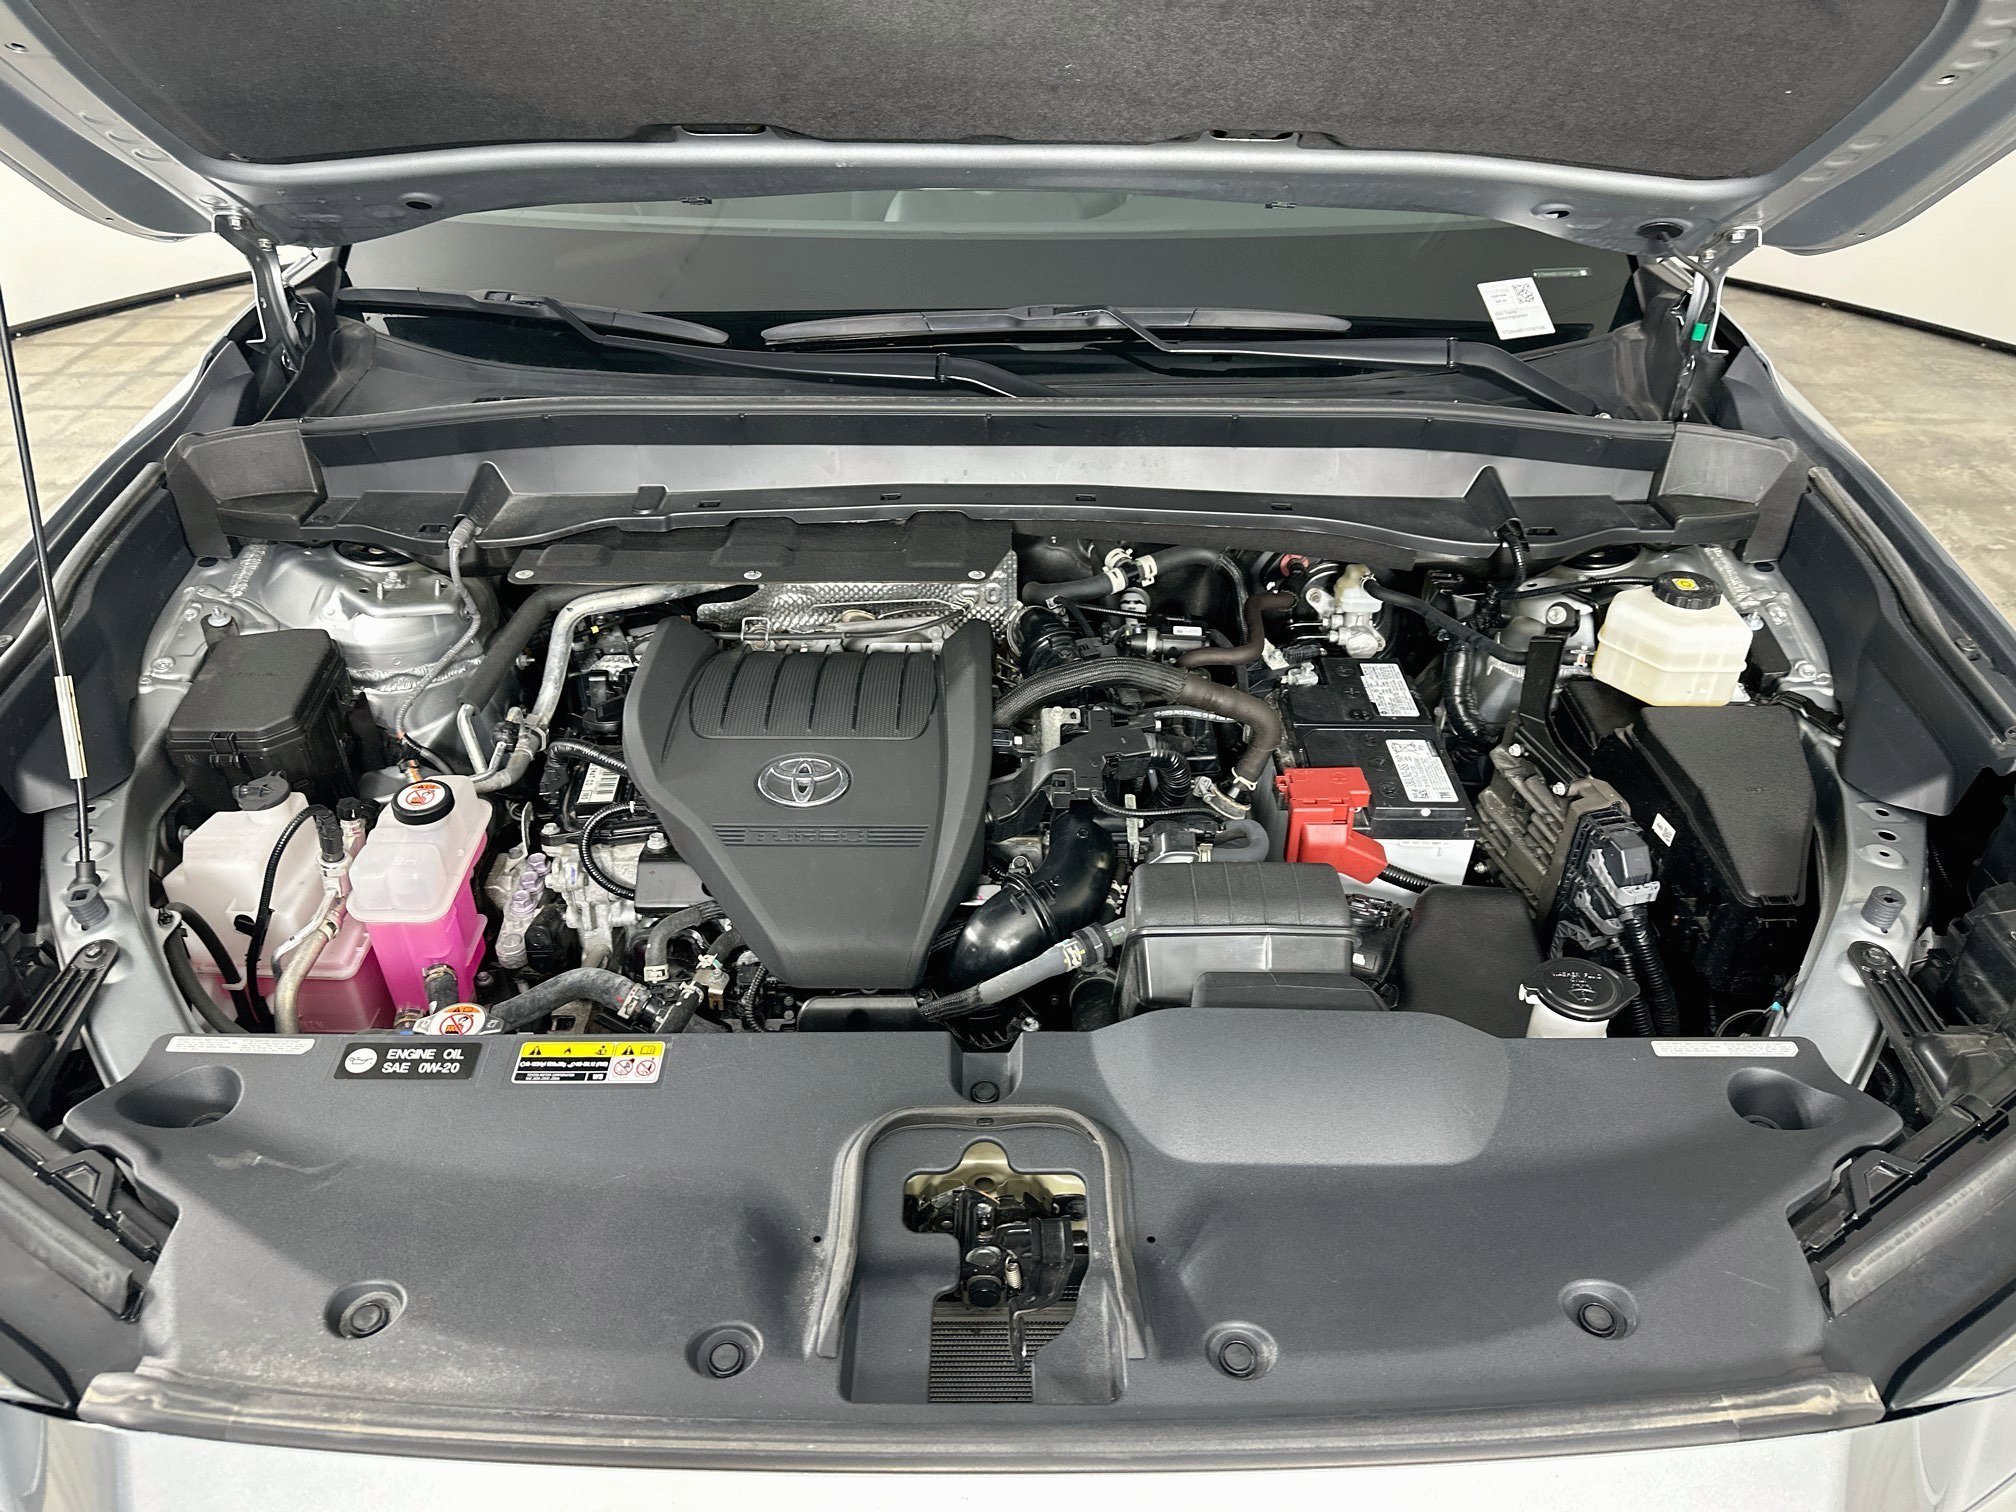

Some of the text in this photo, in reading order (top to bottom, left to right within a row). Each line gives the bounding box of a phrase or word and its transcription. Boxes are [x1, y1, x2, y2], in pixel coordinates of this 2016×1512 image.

[750, 829, 864, 843] TURBO
[386, 1048, 465, 1060] ENGINE OIL
[381, 1062, 461, 1074] SAE 0W-20
